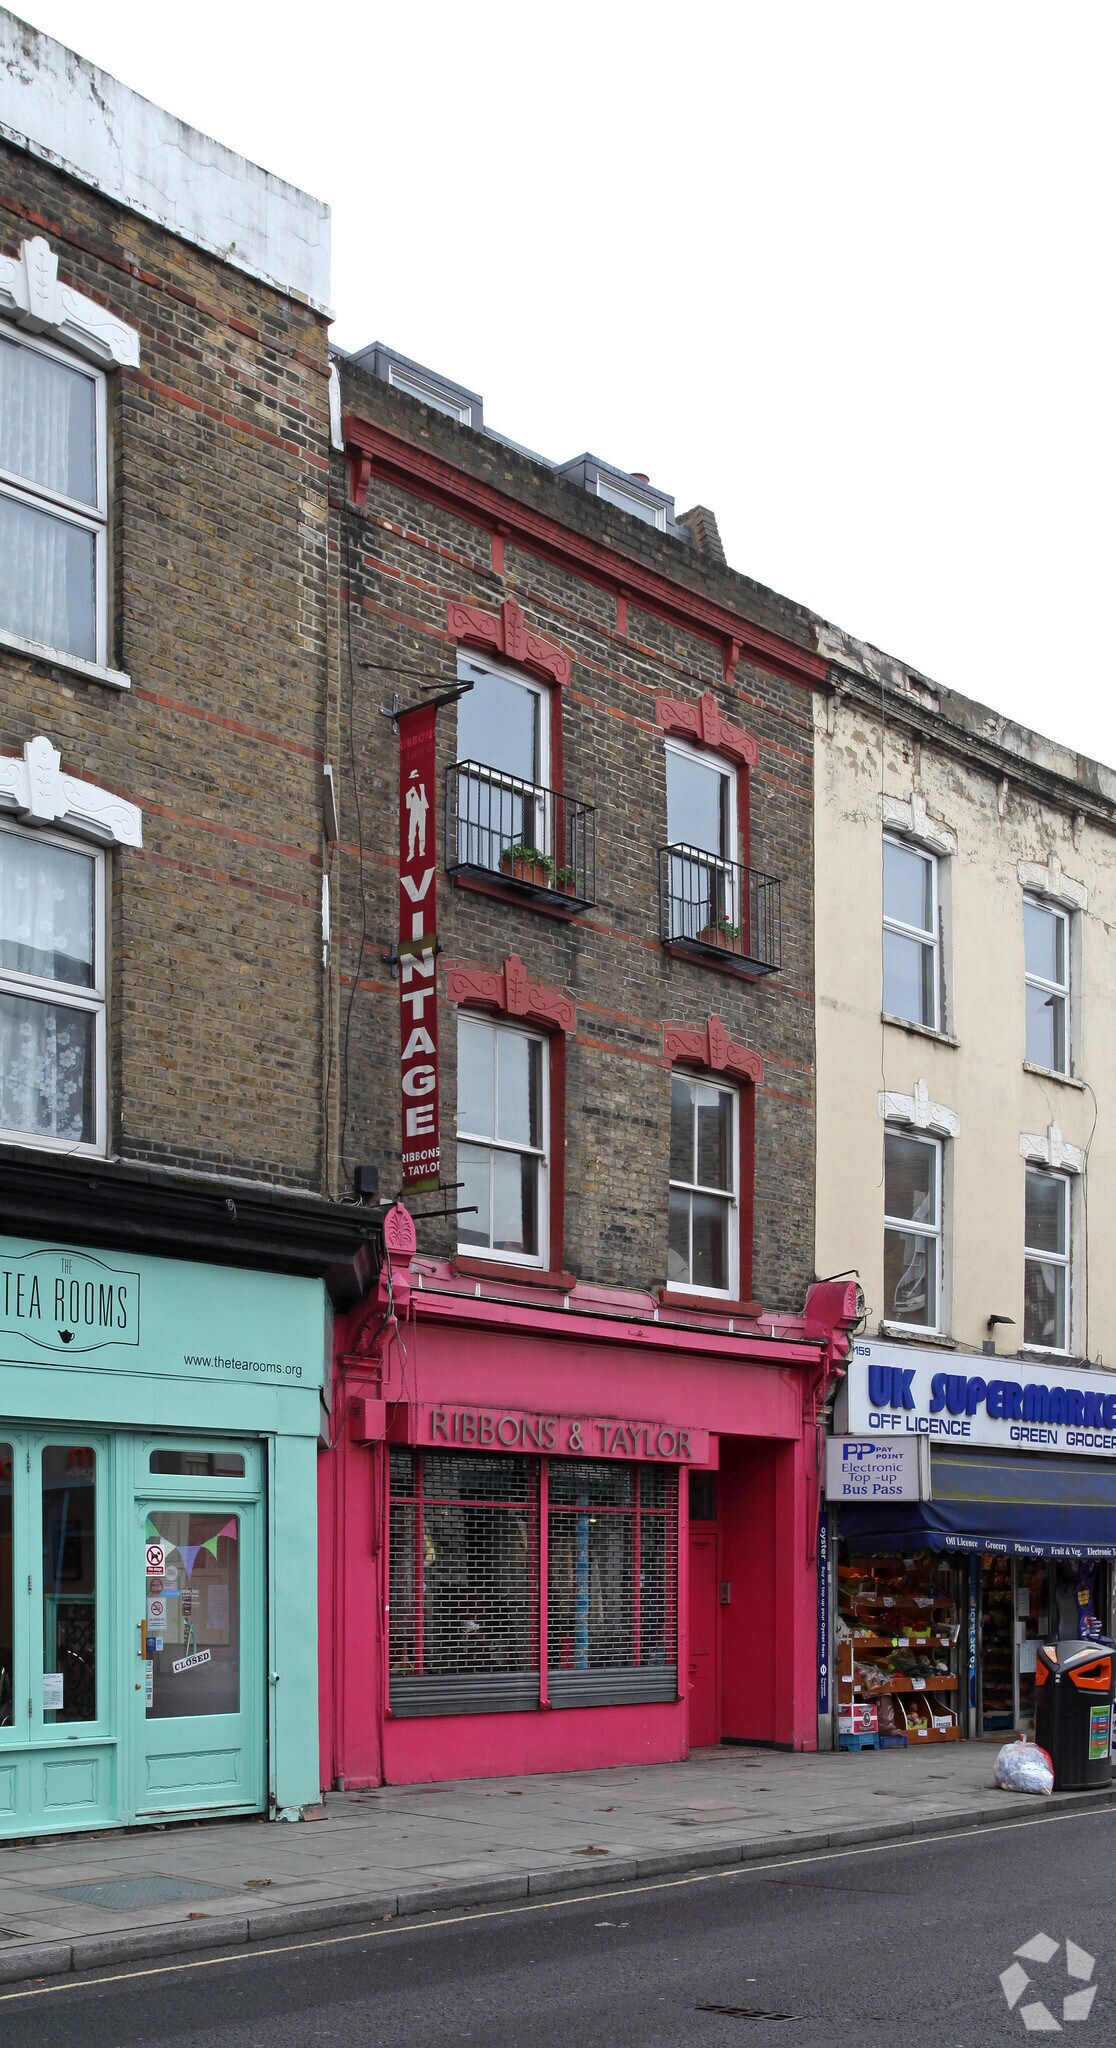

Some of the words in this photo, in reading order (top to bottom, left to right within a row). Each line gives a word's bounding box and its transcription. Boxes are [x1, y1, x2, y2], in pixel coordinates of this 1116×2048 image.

[400, 866, 436, 1138] VINTAGE
[402, 1147, 440, 1163] RIBBONS
[61, 1258, 72, 1275] THE
[2, 1271, 41, 1319] TEA
[54, 1278, 127, 1328] ROOMS
[854, 1346, 871, 1356] 159
[184, 1354, 303, 1378] www.thetearooms.org
[868, 1365, 916, 1409] UK
[869, 1412, 901, 1430] OFF
[906, 1416, 971, 1436] LICENCE
[432, 1410, 556, 1448] RIBBONS
[569, 1421, 585, 1450] &
[597, 1424, 693, 1458] TAYLOR
[1010, 1426, 1058, 1444] GREEN
[841, 1463, 903, 1472] Electronic
[848, 1473, 871, 1484] Top
[842, 1484, 868, 1495] Bus
[872, 1484, 903, 1495] Pass
[819, 1526, 828, 1560] oyster
[945, 1536, 956, 1545] Off
[956, 1537, 979, 1548] Licence
[985, 1540, 1007, 1552] Grocery
[1014, 1543, 1030, 1553] Photo
[1030, 1545, 1044, 1556] Copy
[1051, 1546, 1064, 1555] Fruit
[1070, 1547, 1082, 1557] Veg.
[1087, 1547, 1112, 1556] Electronic
[174, 1652, 210, 1671] CLOSED
